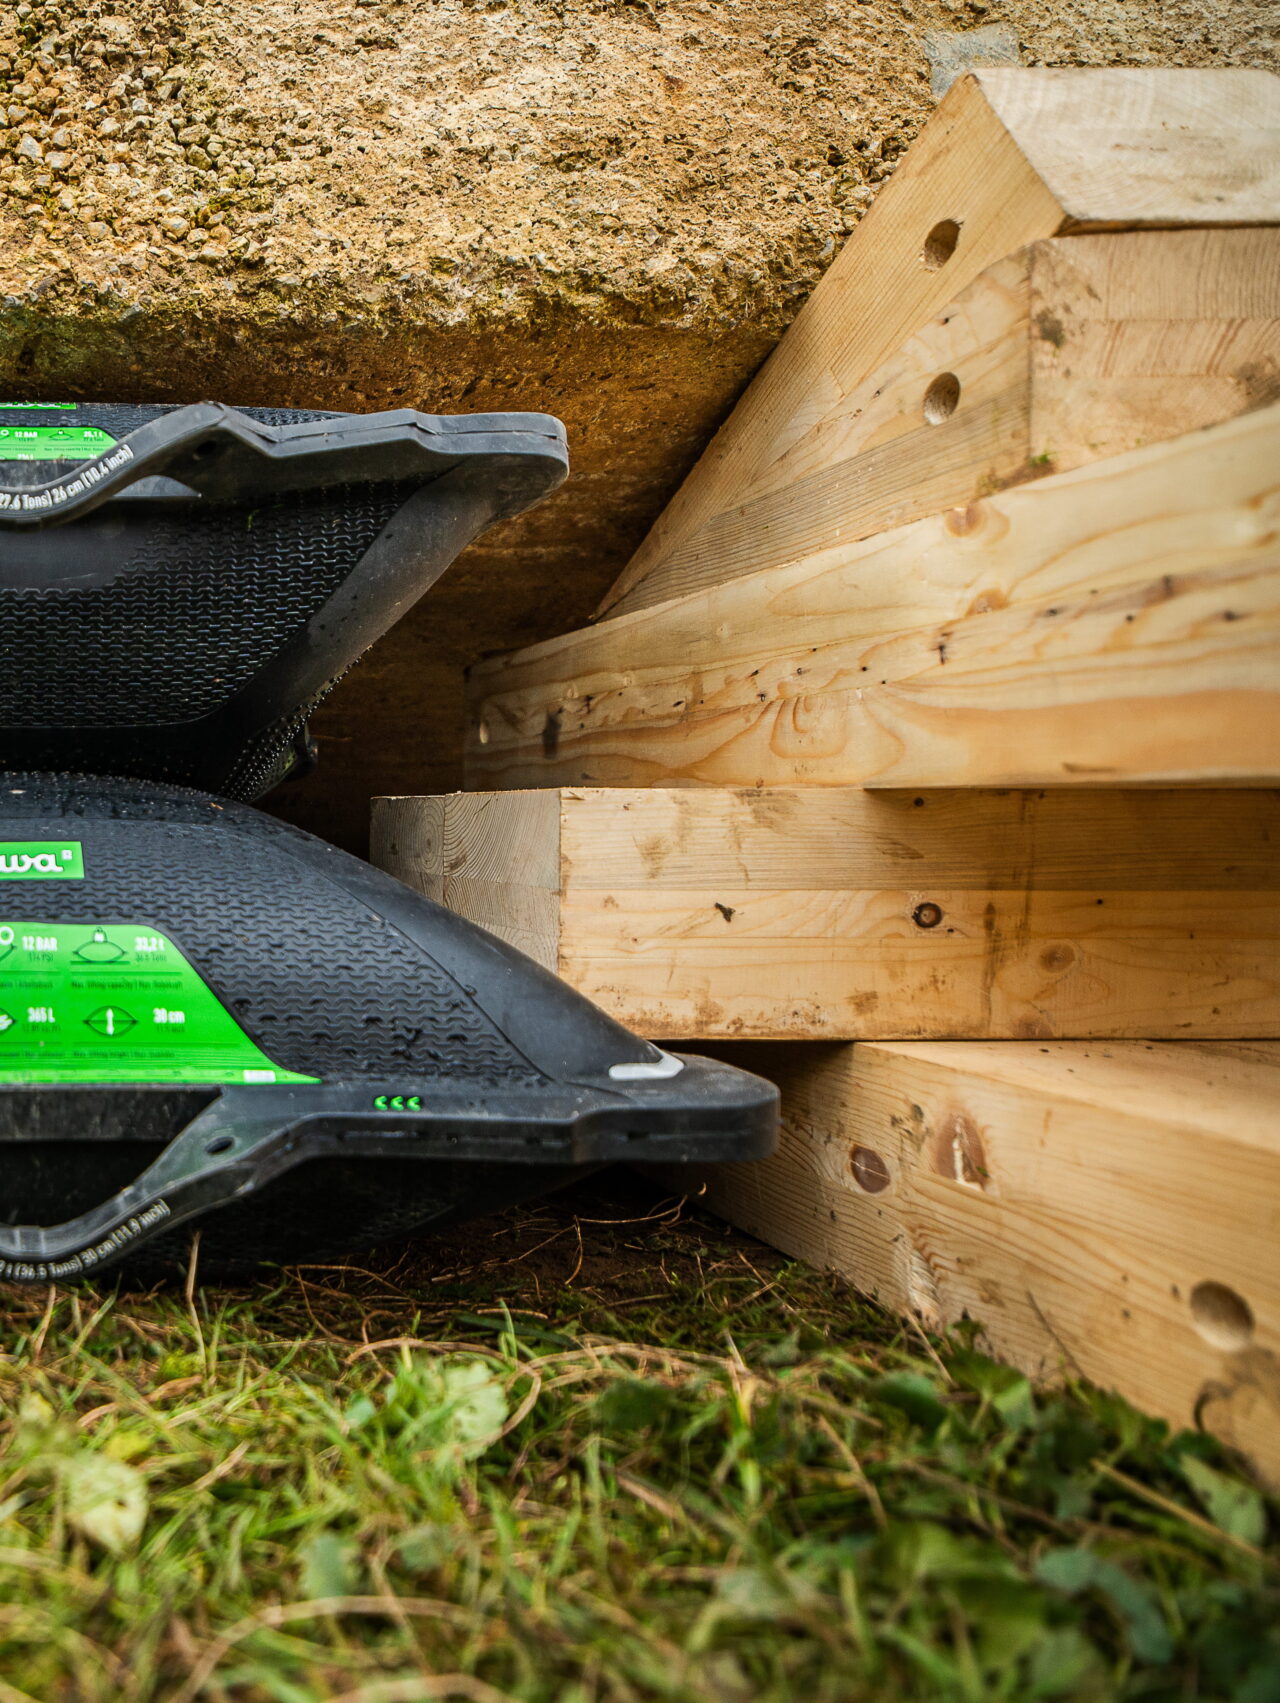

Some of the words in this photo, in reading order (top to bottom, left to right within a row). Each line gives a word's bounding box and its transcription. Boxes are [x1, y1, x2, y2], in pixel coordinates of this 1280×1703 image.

[21, 489, 53, 510] Tons)
[51, 485, 68, 504] 26
[65, 479, 85, 497] cm
[80, 462, 110, 489] (10.4
[105, 444, 134, 471] inch)
[22, 936, 35, 951] 12
[35, 936, 58, 951] BAR
[153, 1007, 168, 1024] 30
[167, 1010, 186, 1024] cm
[80, 1248, 99, 1267] 30
[95, 1240, 117, 1259] cm
